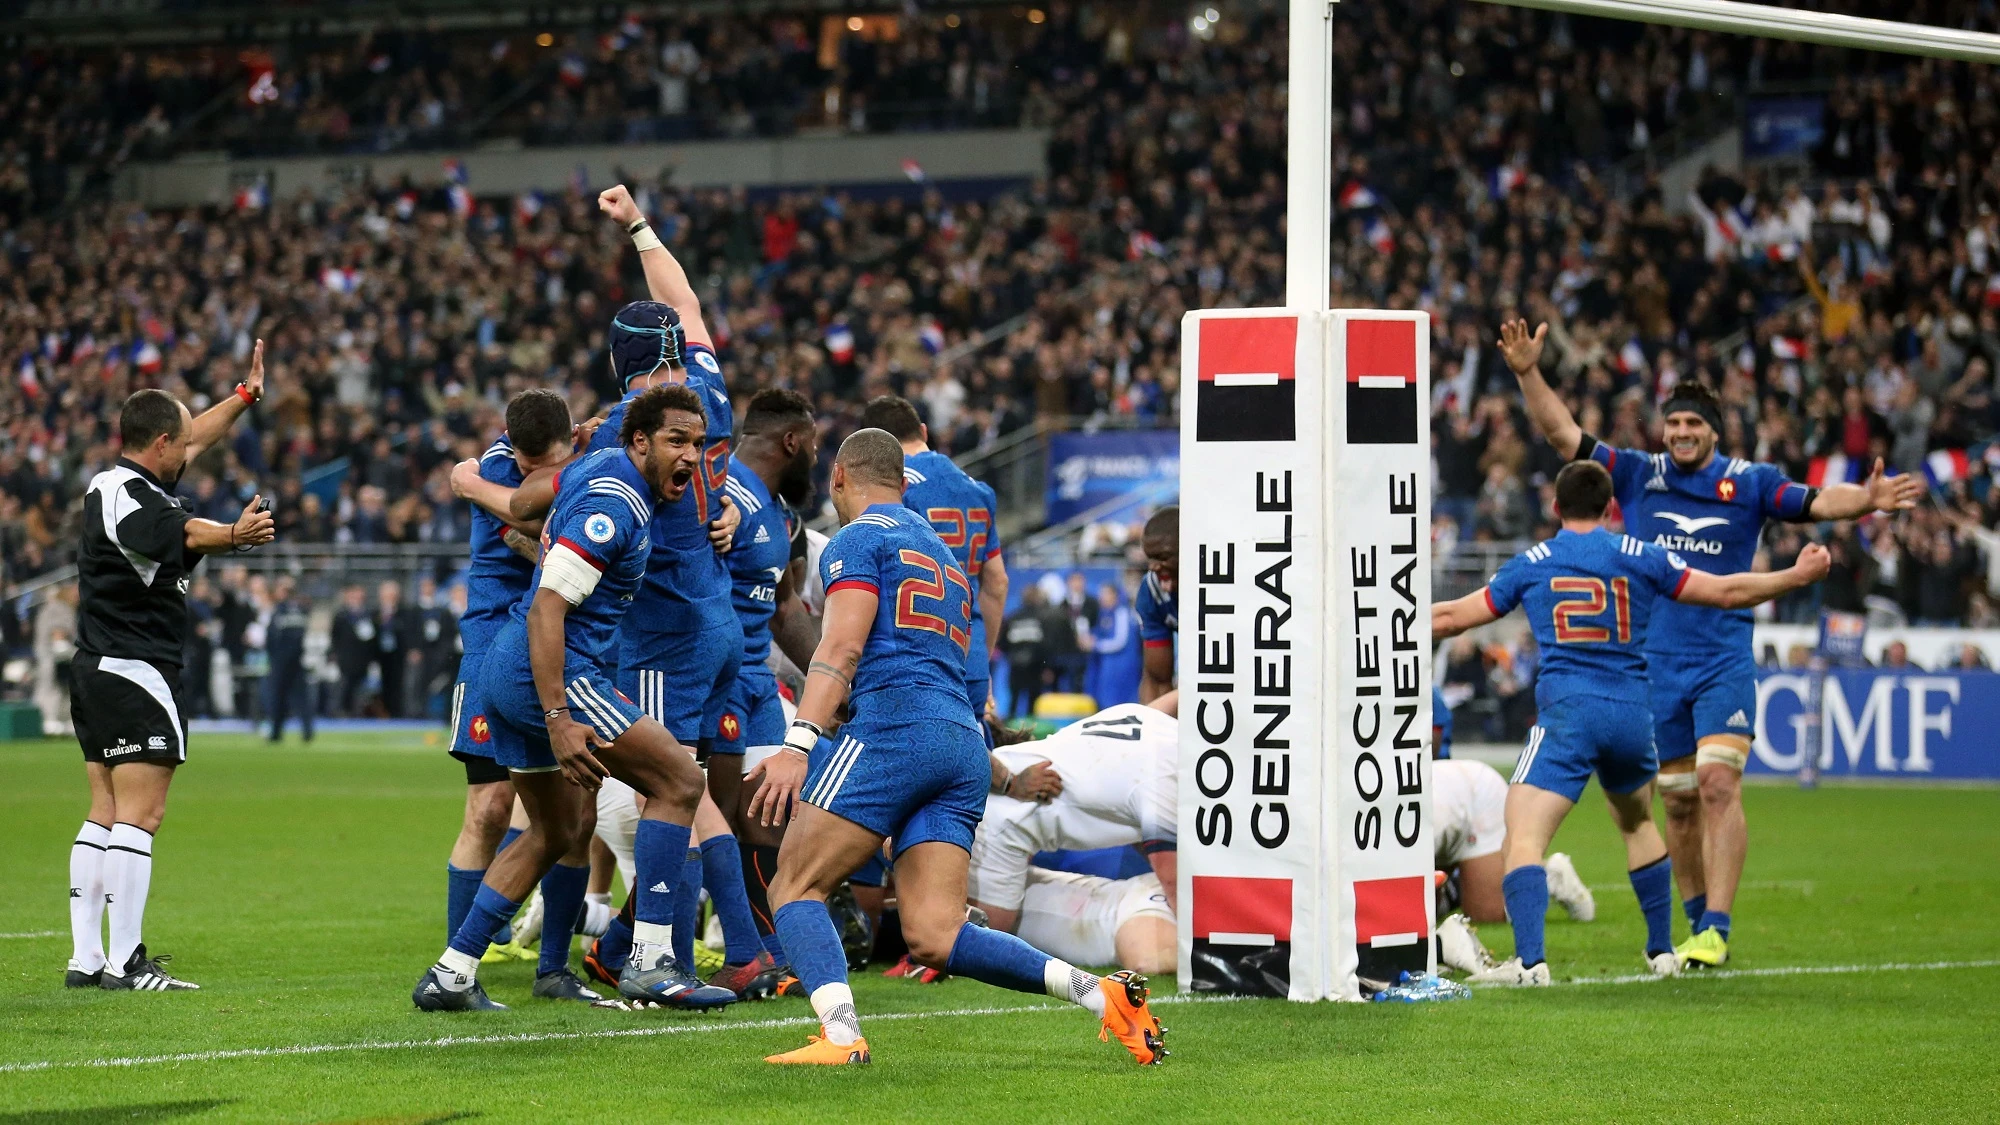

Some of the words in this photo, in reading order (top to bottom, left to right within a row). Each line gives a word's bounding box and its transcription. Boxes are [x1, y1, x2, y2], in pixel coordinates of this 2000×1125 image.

[927, 507, 992, 576] 22
[1654, 533, 1723, 555] ALTRAD
[895, 548, 972, 652] 23
[1550, 576, 1631, 644] 21
[1196, 542, 1235, 848] SOCIETE
[1250, 470, 1293, 849] GENERALE
[1351, 545, 1383, 850] SOCIETE
[1389, 473, 1422, 848] GENERALE
[103, 744, 142, 758] Emirates
[1080, 715, 1143, 741] 17
[1751, 672, 1960, 772] GMF
